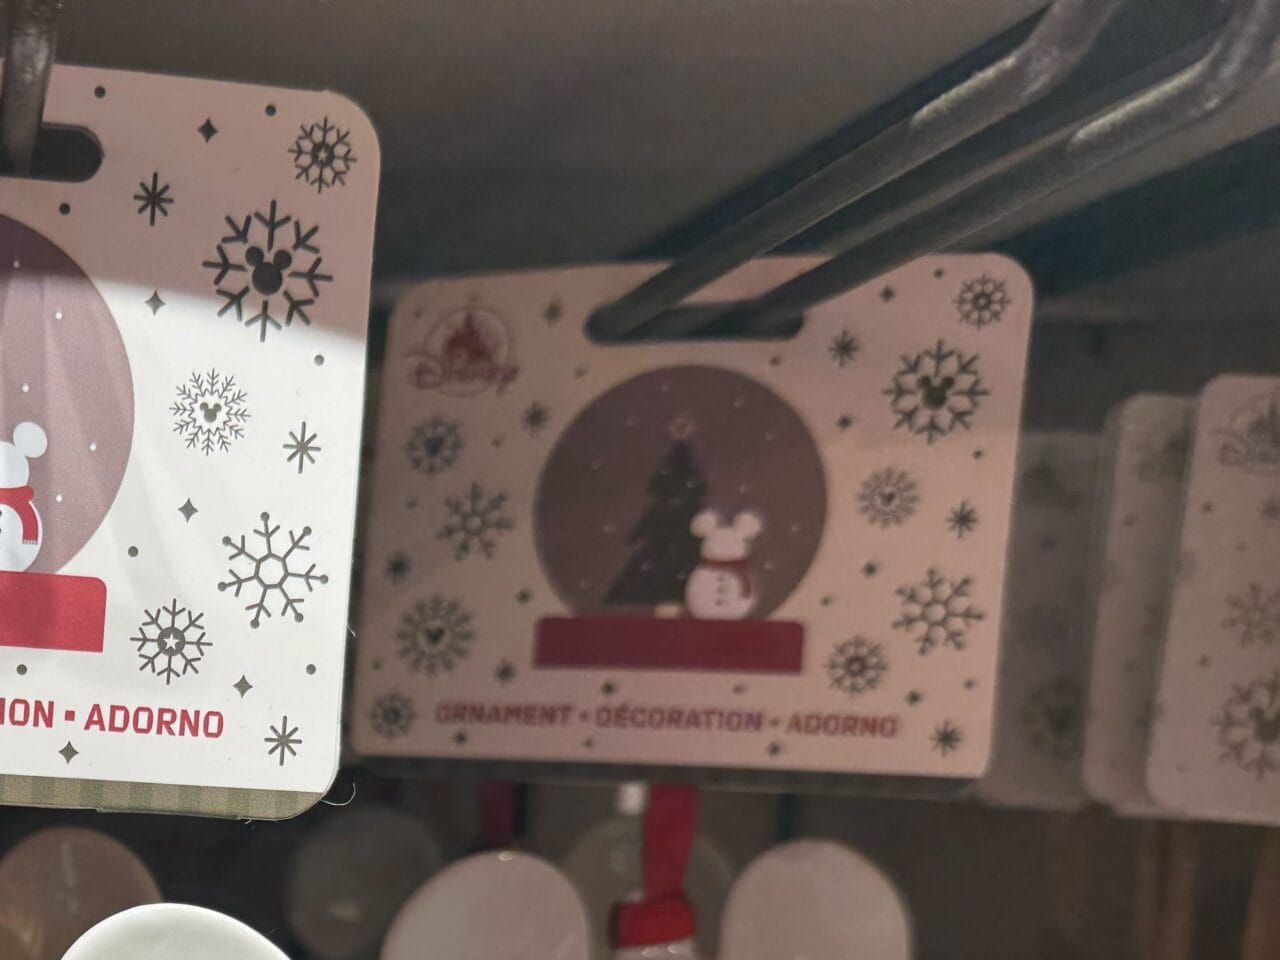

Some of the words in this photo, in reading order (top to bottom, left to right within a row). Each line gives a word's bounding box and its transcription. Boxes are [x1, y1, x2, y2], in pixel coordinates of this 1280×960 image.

[83, 702, 225, 739] ADORNO
[434, 703, 573, 726] ORNAMENT
[785, 711, 900, 739] ADORNO
